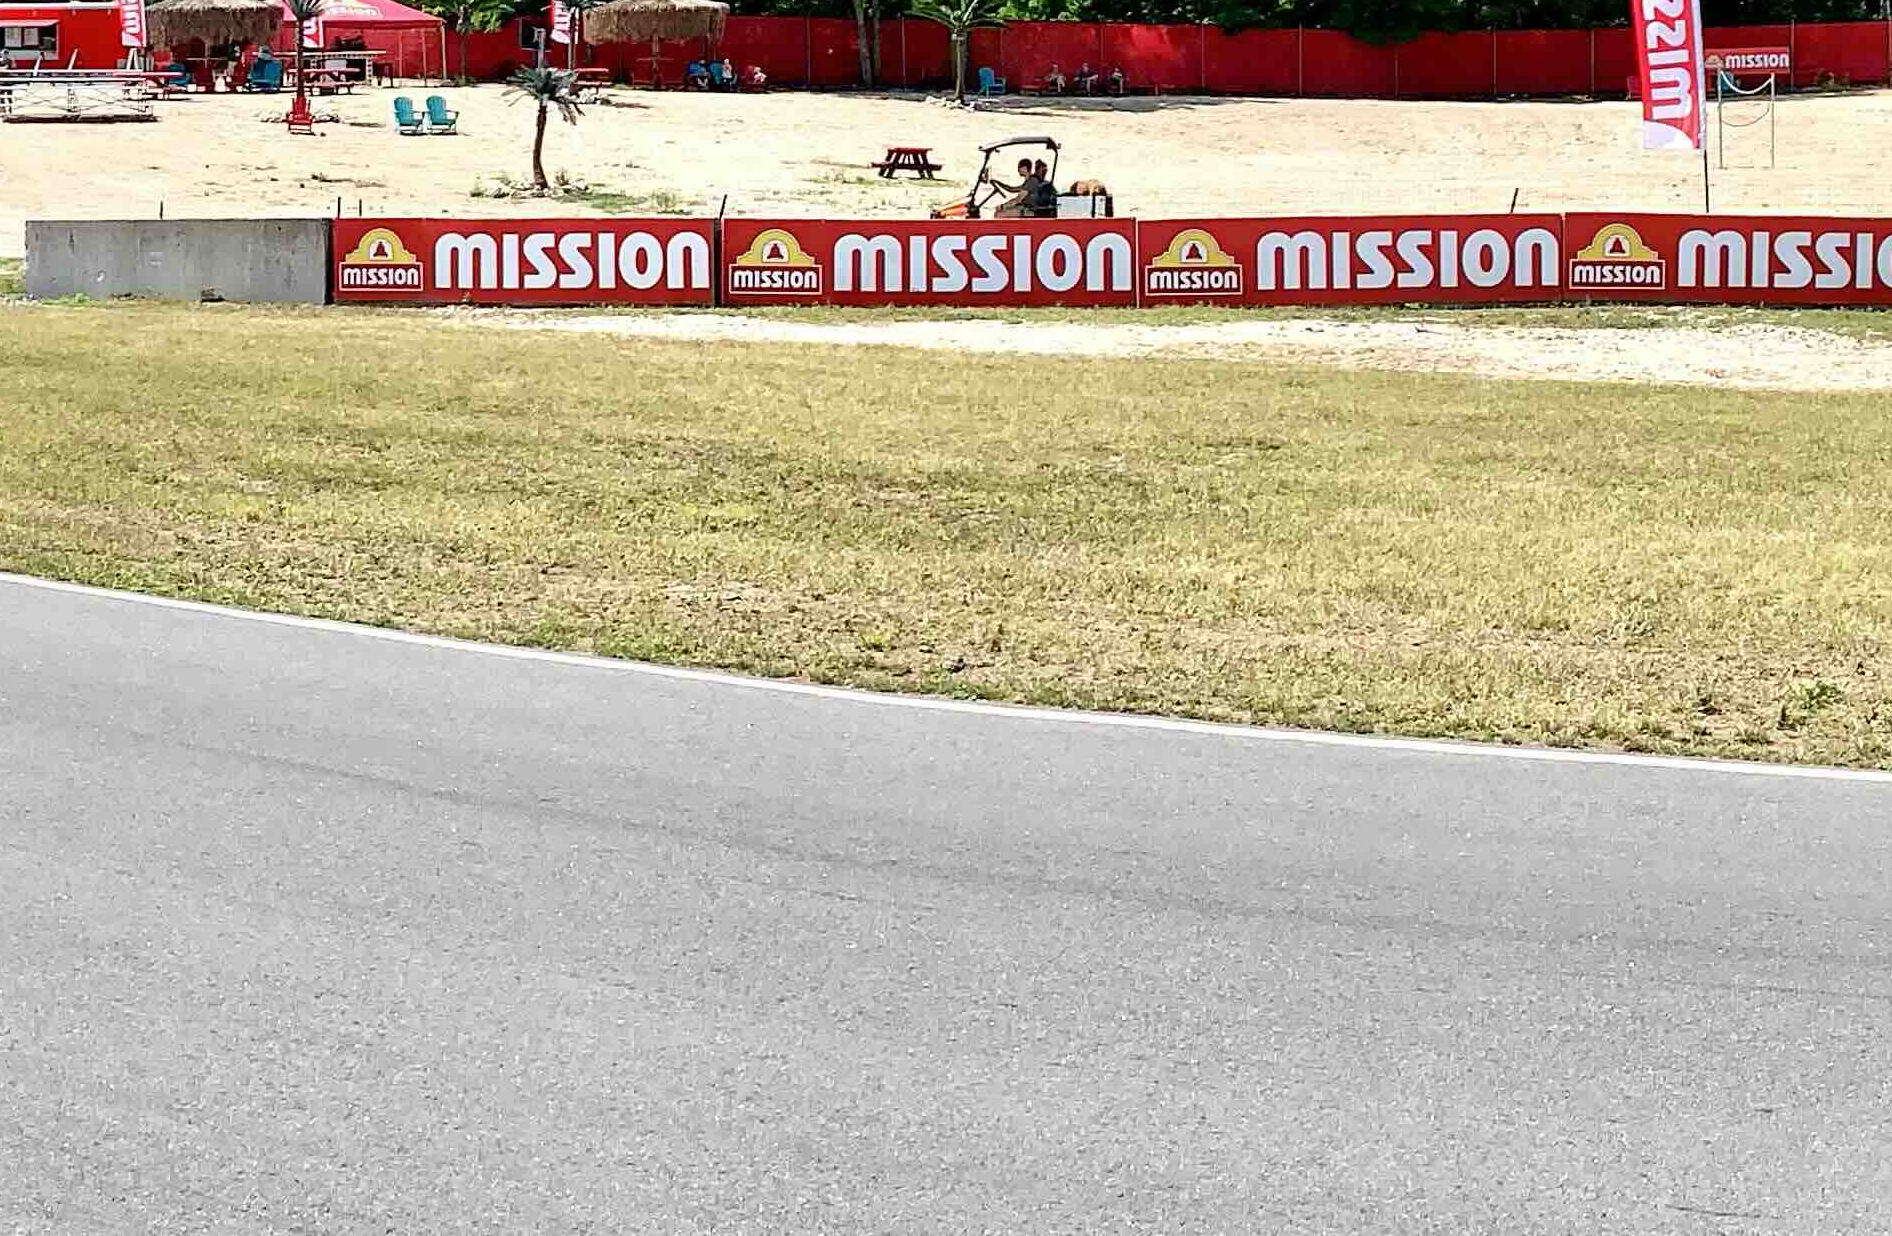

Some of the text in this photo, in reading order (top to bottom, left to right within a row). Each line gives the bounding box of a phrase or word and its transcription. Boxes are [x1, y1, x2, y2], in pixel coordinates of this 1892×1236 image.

[1725, 51, 1790, 69] MISSION
[435, 231, 710, 290] MISSION
[834, 233, 1133, 294] MISSION
[1258, 229, 1559, 289] MISSION
[342, 267, 420, 285] MISSION
[733, 269, 820, 290] MISSION
[1149, 269, 1240, 291] MISSION
[1572, 264, 1662, 285] MISSION
